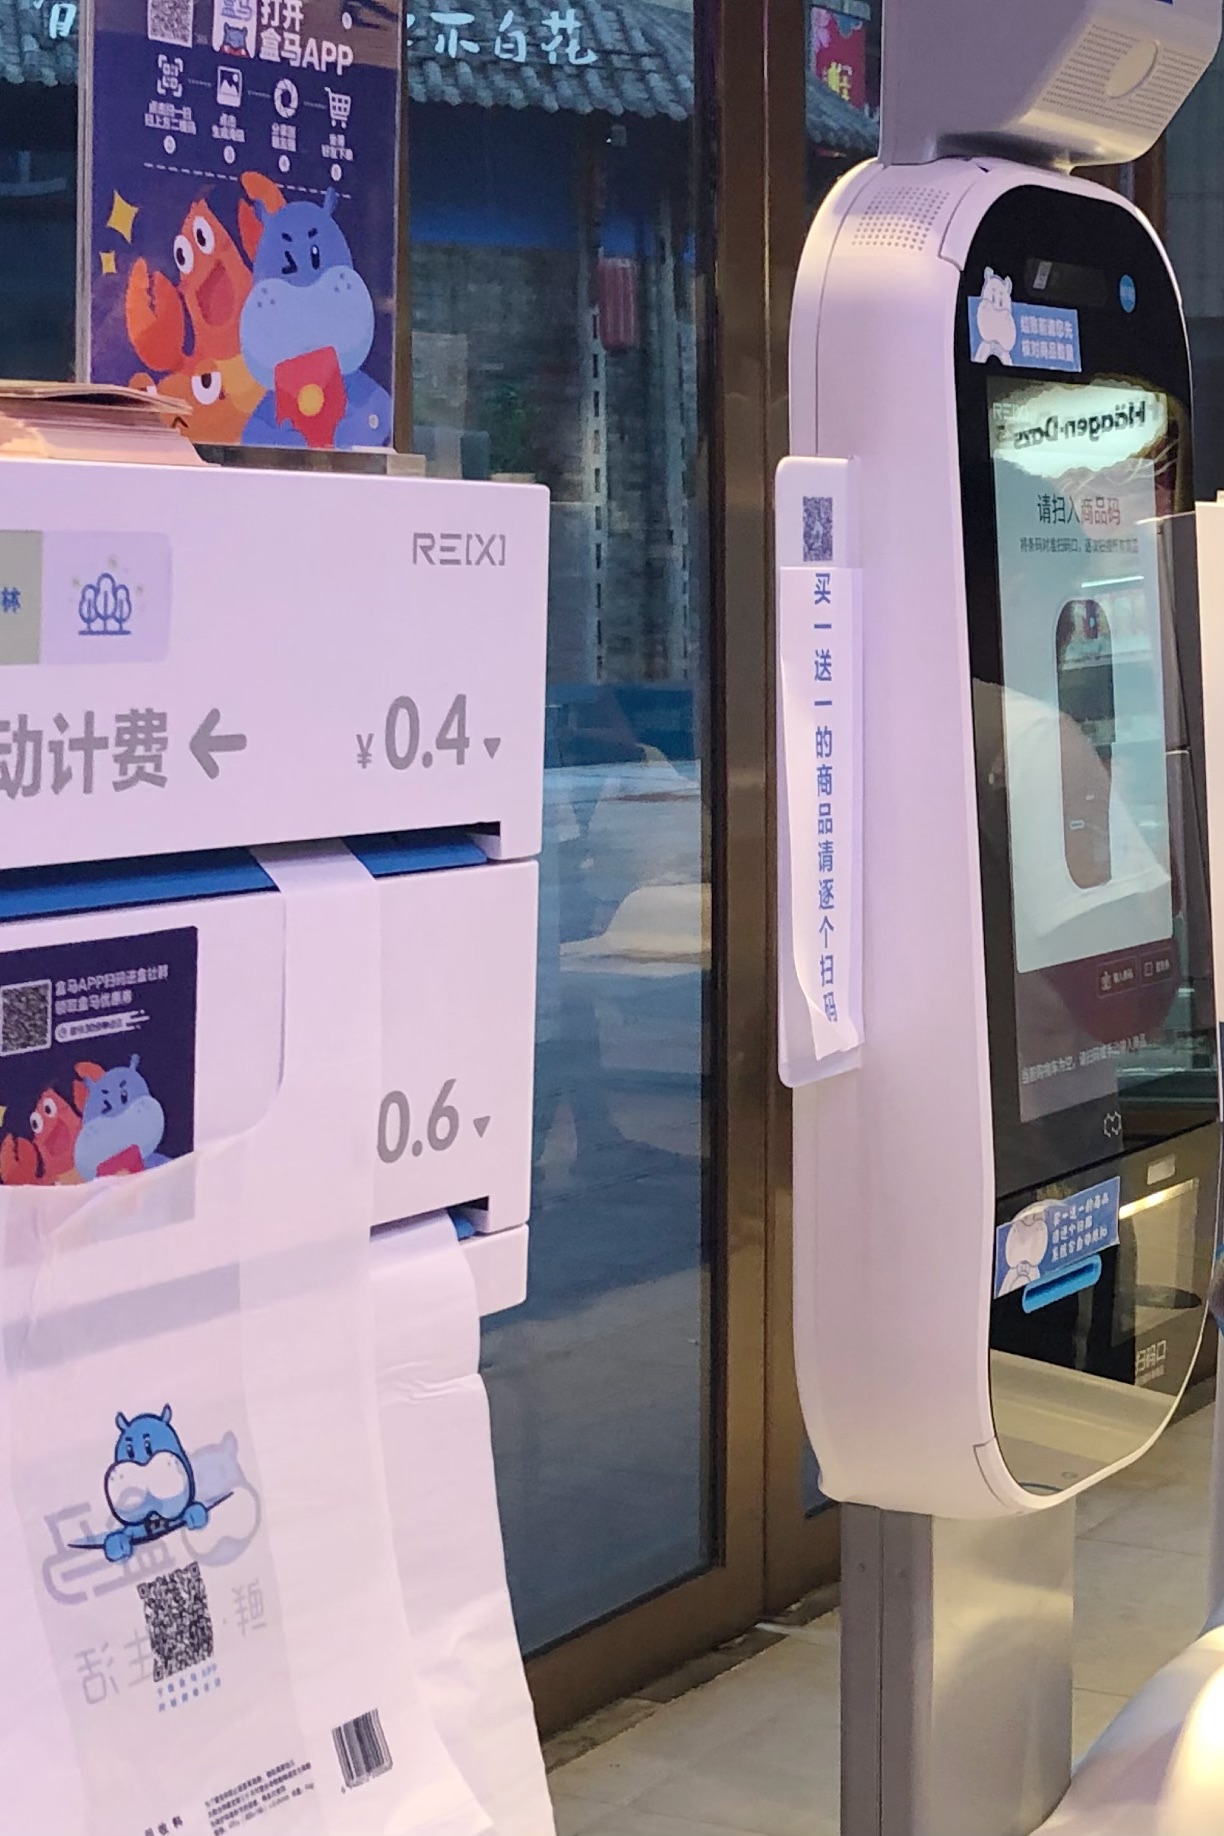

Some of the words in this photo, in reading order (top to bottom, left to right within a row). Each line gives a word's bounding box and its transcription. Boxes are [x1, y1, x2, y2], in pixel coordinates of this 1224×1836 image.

[260, 0, 304, 32] 打开
[406, 9, 598, 64] 不白花
[259, 28, 354, 75] 盒马APP
[1037, 493, 1121, 525] 请扫入商品码
[0, 708, 169, 799] 动计费
[814, 572, 838, 1023] 买一送一的商品请逐个扫码
[377, 1078, 460, 1164] 0.6
